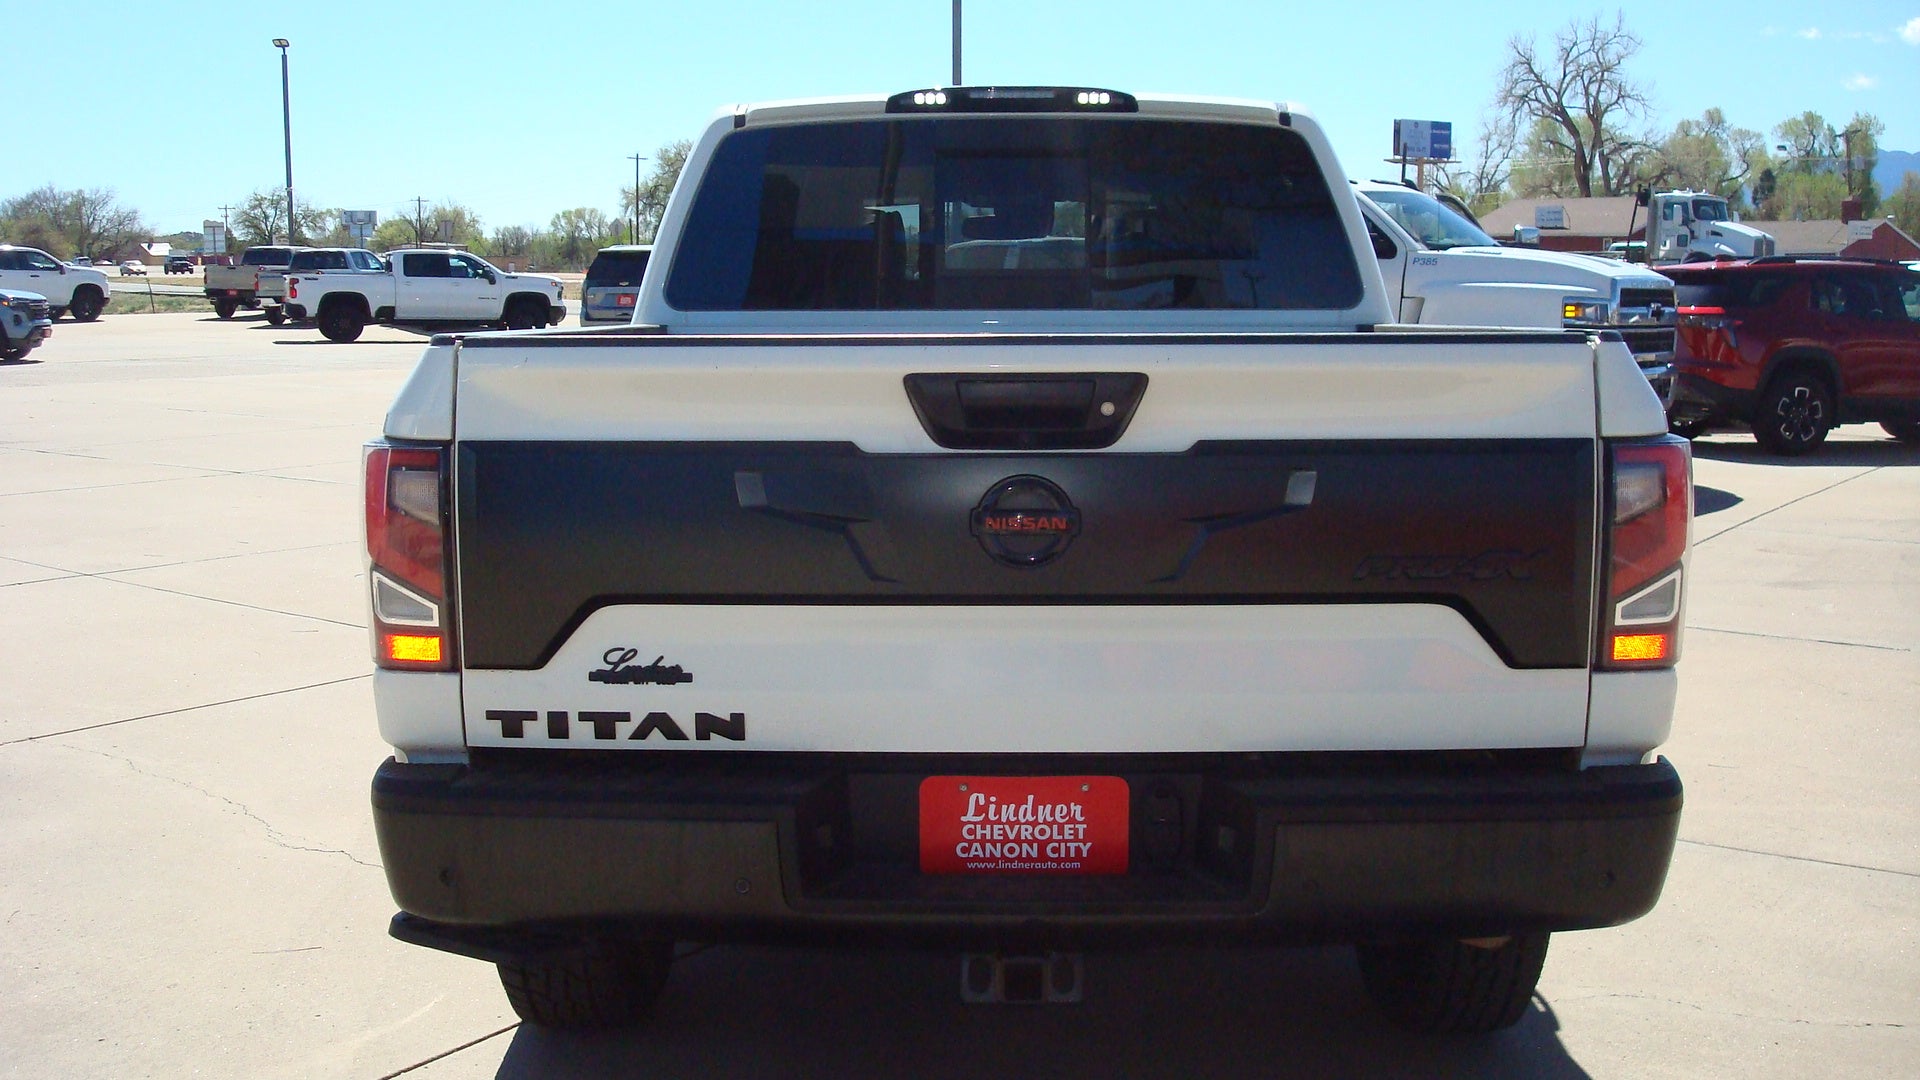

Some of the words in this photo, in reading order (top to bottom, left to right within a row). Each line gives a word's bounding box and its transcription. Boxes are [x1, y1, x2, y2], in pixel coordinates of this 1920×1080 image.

[1412, 257, 1438, 266] P385
[984, 516, 1067, 531] NISSAN
[485, 710, 746, 741] TITAN
[960, 792, 1086, 823] Lindner
[962, 824, 1088, 841] CHEVROLET
[956, 842, 1038, 859] CANON
[1046, 842, 1092, 859] CITY
[966, 860, 1081, 870] www.lindnerauto.com
